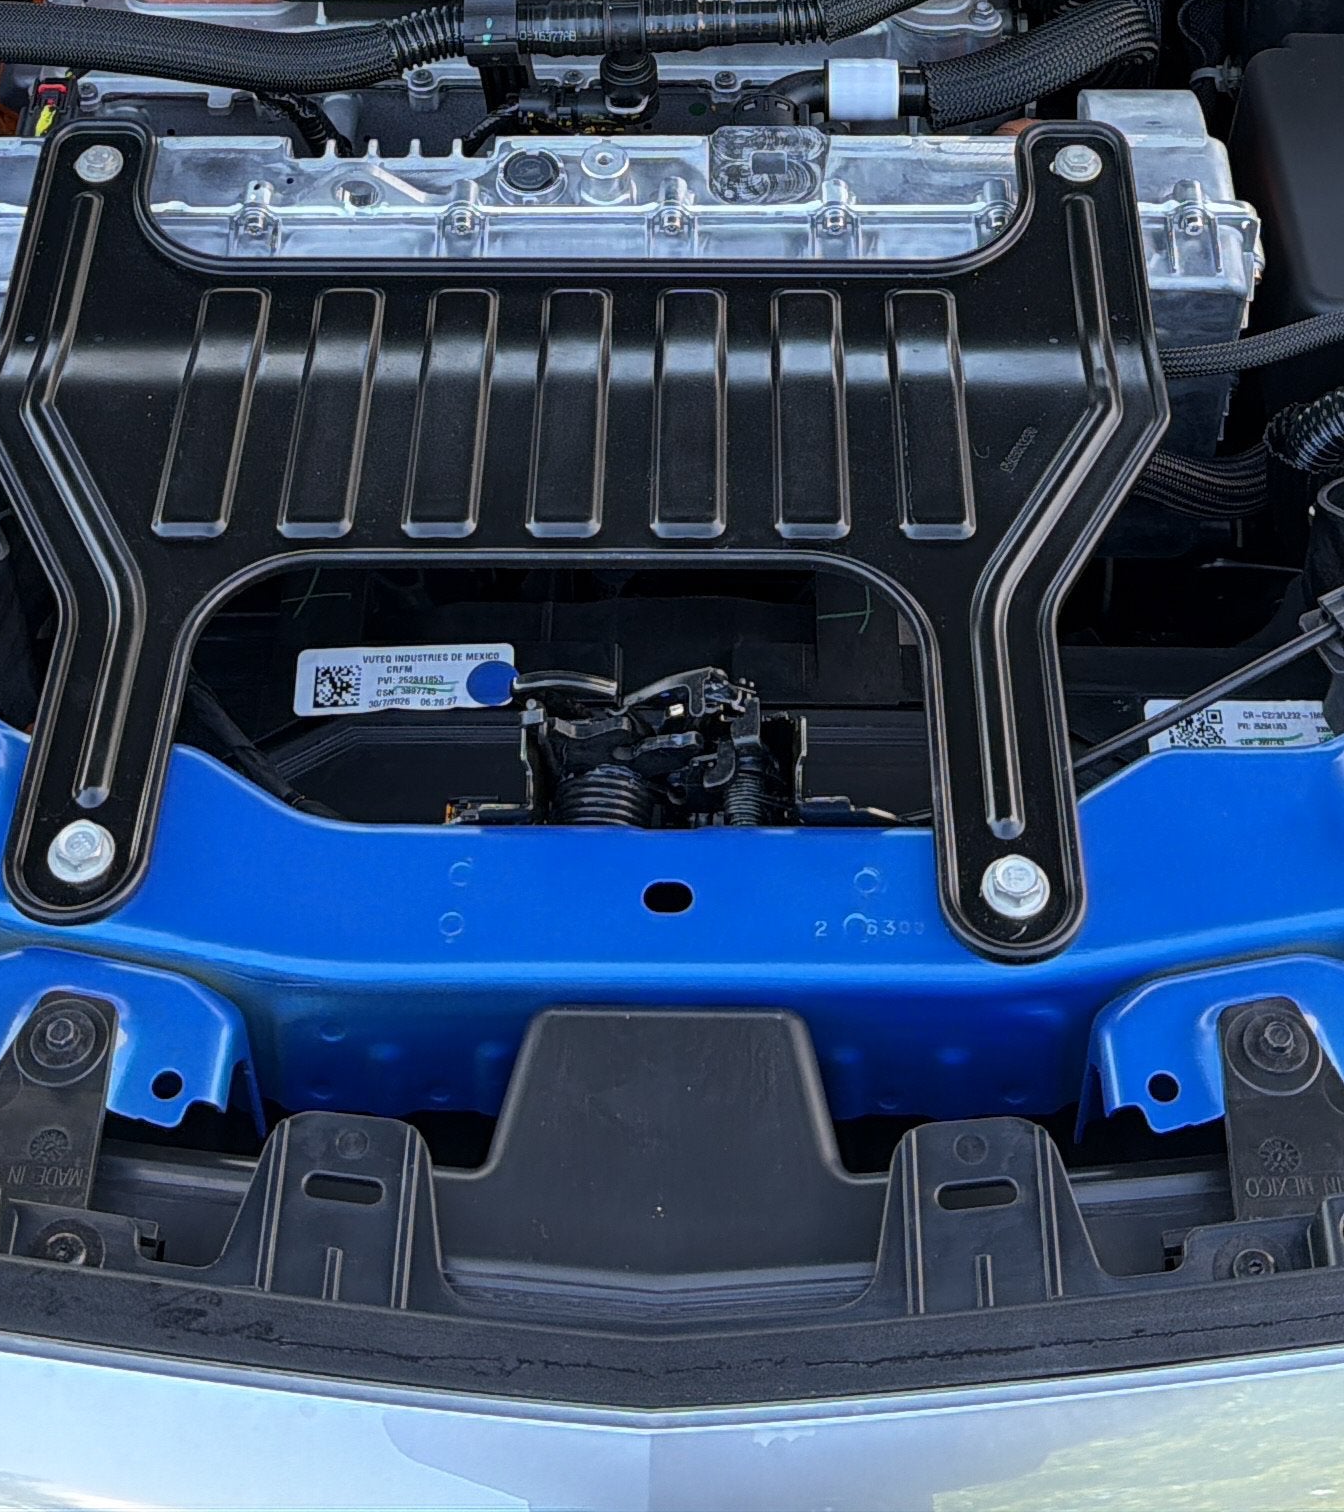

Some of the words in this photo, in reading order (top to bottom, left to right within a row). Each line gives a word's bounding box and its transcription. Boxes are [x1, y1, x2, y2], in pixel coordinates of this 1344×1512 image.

[362, 655, 392, 664] VUTEQ
[394, 653, 449, 663] INDUSTRIES
[451, 653, 463, 661] DE
[465, 651, 500, 661] MEXICO
[386, 665, 413, 674] CRFM
[377, 677, 396, 686] PVI:
[8, 1164, 27, 1184] IN
[39, 1166, 84, 1186] MADE
[1245, 1175, 1314, 1198] MEXICO
[1323, 1175, 1342, 1195] IN
